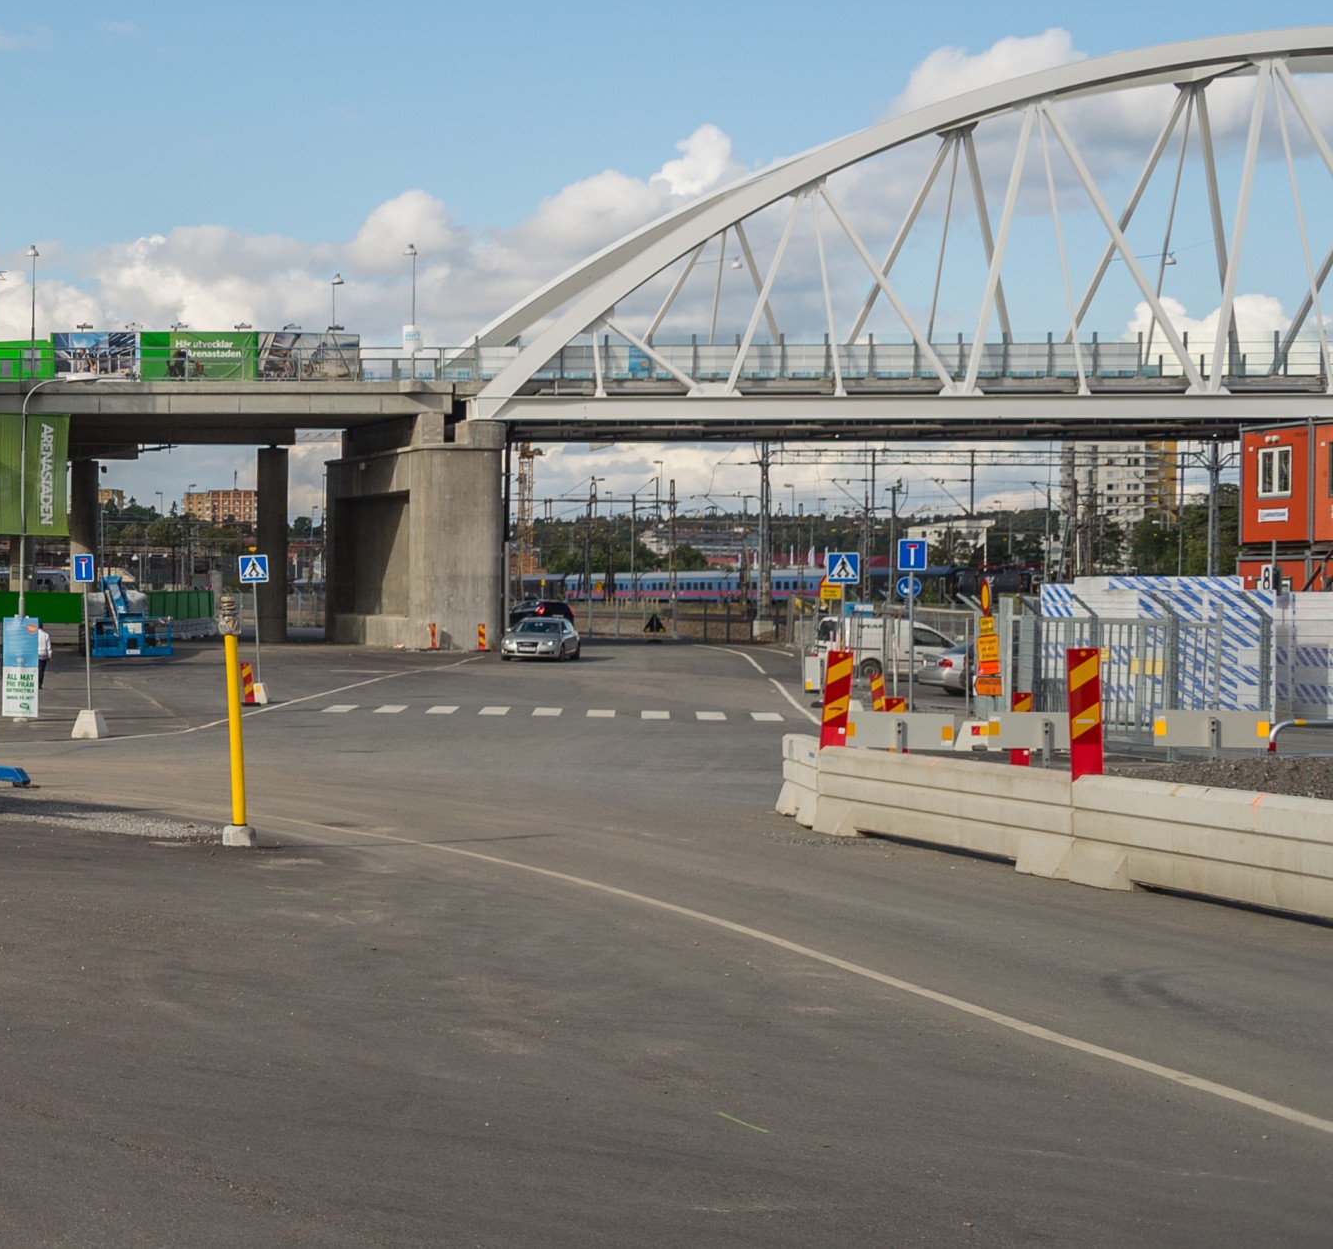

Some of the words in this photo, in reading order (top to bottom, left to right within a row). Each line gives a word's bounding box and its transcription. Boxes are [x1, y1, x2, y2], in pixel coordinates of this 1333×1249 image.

[175, 339, 191, 348] Här
[193, 339, 233, 348] utvecklar
[187, 349, 241, 358] Arenastaden
[40, 422, 54, 525] ARENASTADEN
[6, 673, 18, 681] ALL
[20, 673, 35, 681] MAT
[17, 680, 35, 688] FRÅN
